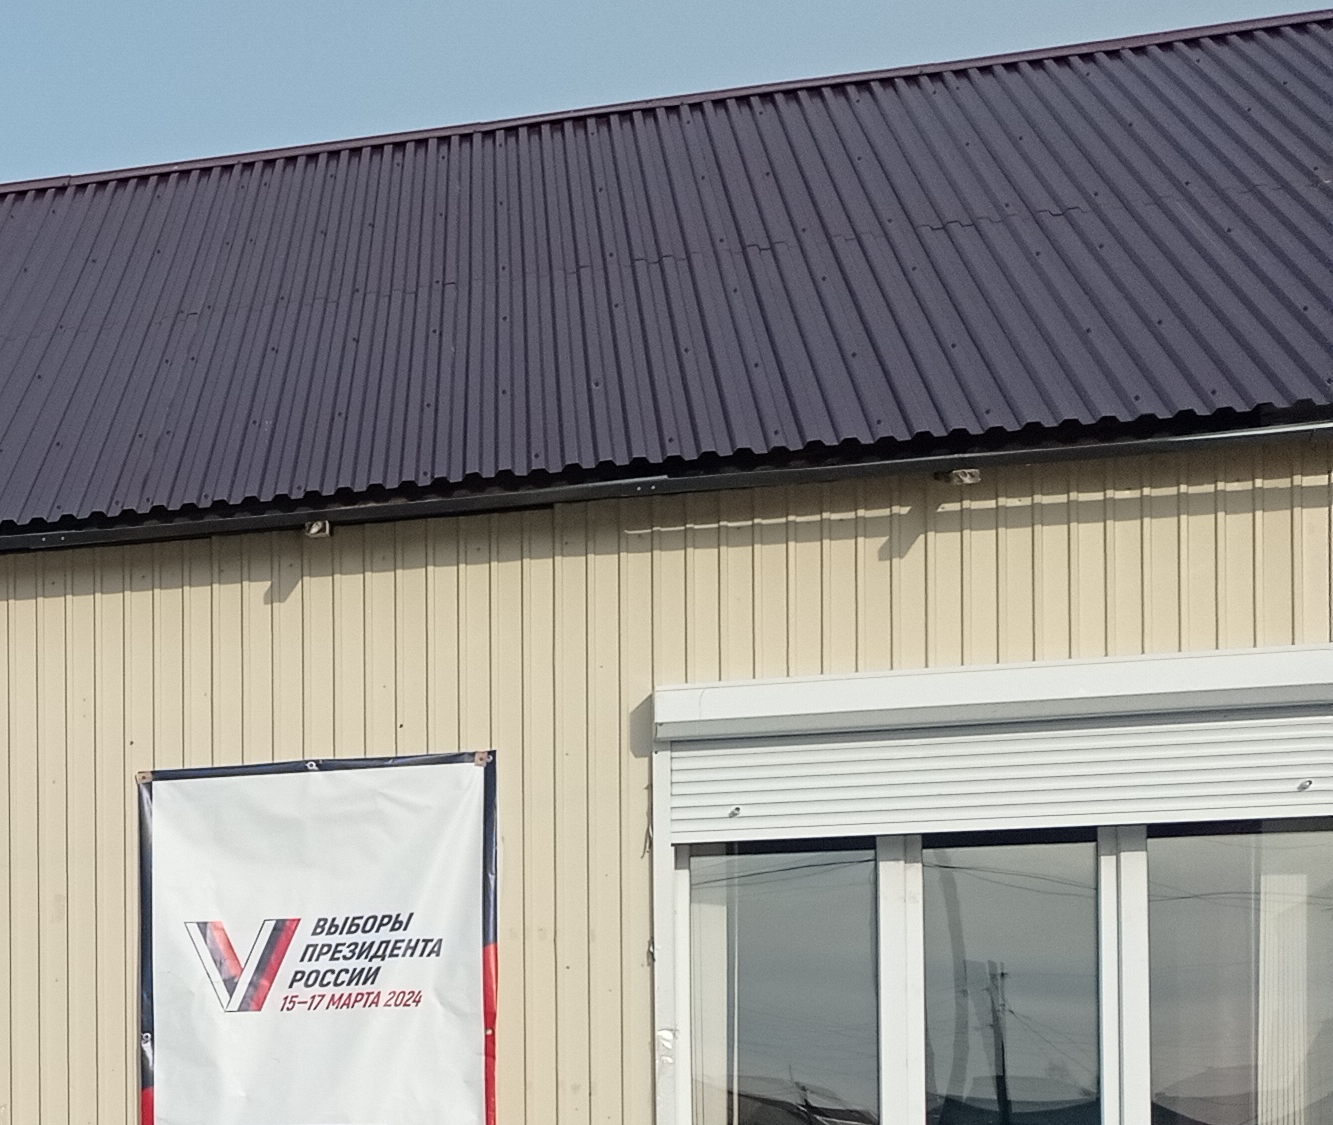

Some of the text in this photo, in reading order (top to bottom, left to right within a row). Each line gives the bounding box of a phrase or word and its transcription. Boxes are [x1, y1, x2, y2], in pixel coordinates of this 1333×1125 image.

[311, 912, 415, 937] ВЫБОРЫ
[299, 938, 444, 963] ПРЕЗИДЕНТА
[288, 965, 382, 989] РОССИИ
[325, 991, 382, 1010] МАРТА
[383, 990, 423, 1007] 2024
